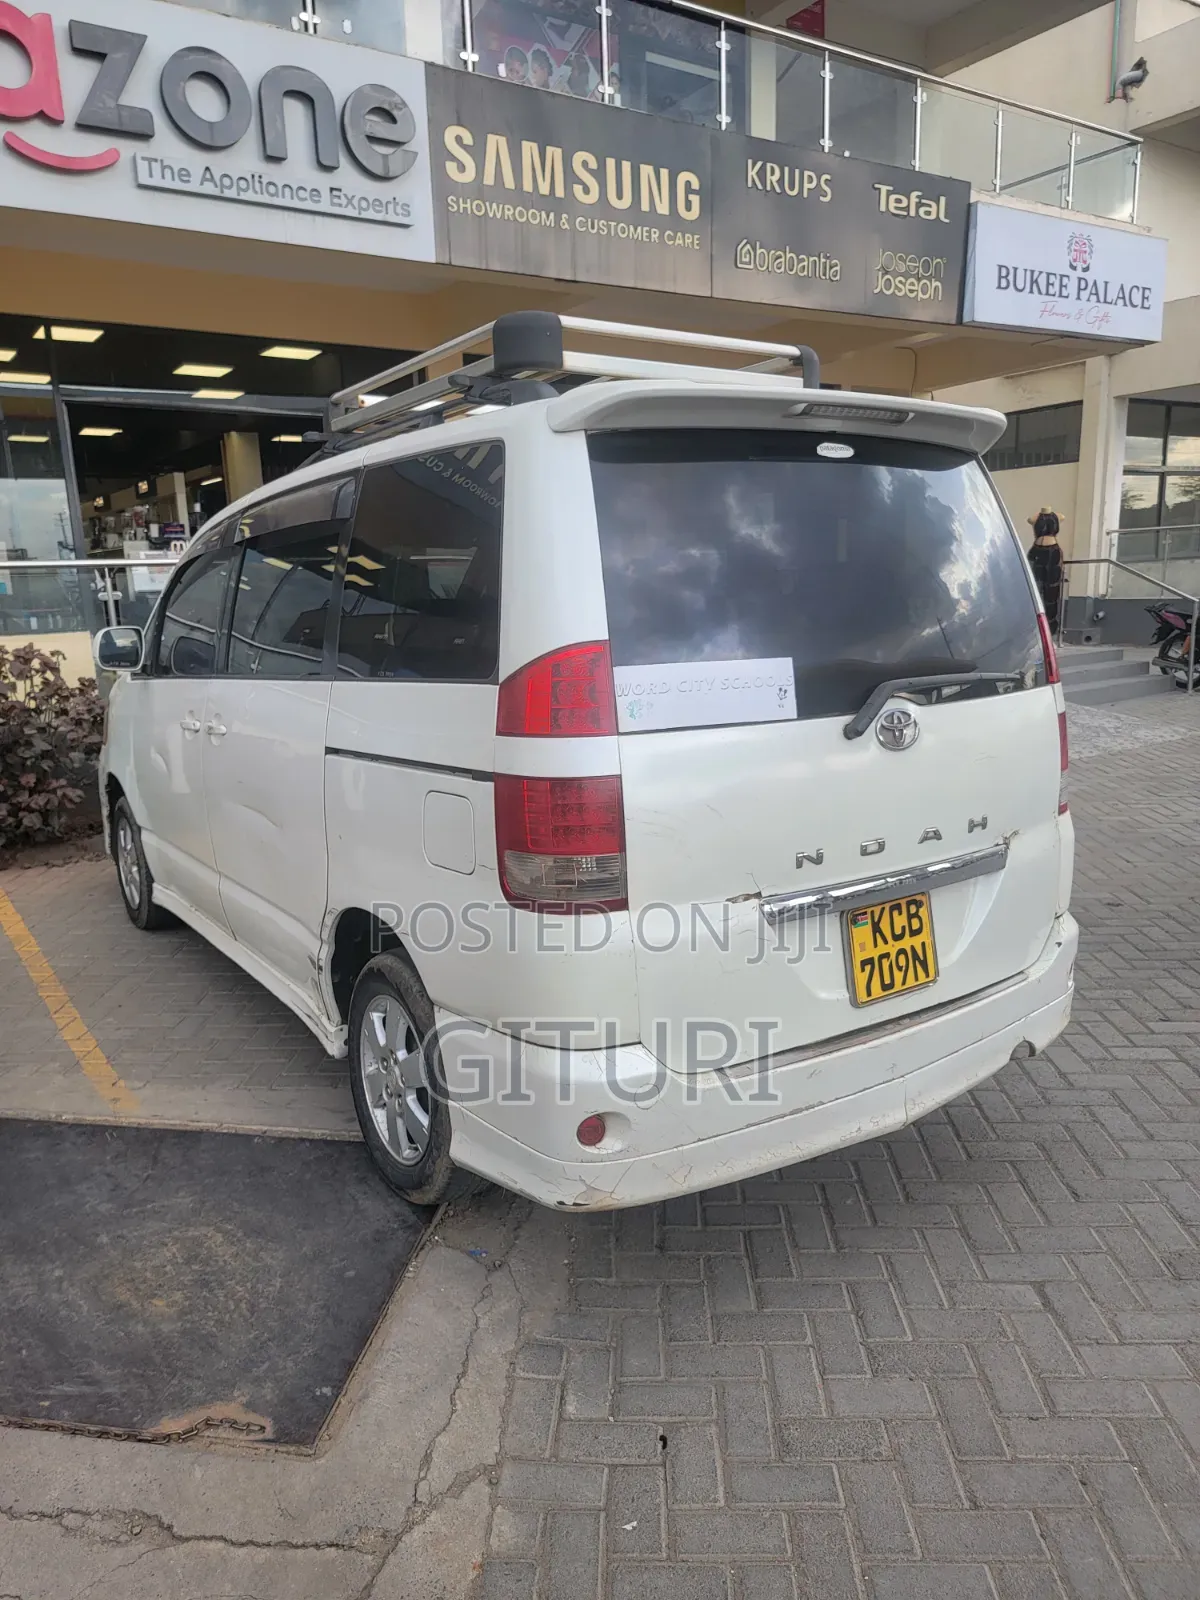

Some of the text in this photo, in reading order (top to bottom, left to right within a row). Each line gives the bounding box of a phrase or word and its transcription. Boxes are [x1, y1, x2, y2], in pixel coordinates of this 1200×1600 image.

[141, 156, 412, 218] The Appliance Experts
[444, 125, 701, 221] SAMSUNG
[747, 159, 832, 203] KRUPS
[447, 195, 701, 250] SHOWROOM & CUSTOMER CARE
[873, 183, 950, 223] Tefal
[755, 241, 841, 282] brabantia
[872, 248, 944, 278] Joseph
[872, 271, 943, 302] Joseph
[996, 264, 1152, 310] BUKEE PALACE
[1039, 300, 1112, 331] Flowers & Gifts
[615, 674, 794, 698] WORD CITY SCHOOLS
[796, 814, 988, 869] NOAH
[870, 898, 923, 948] KCB
[860, 941, 930, 997] 709N
